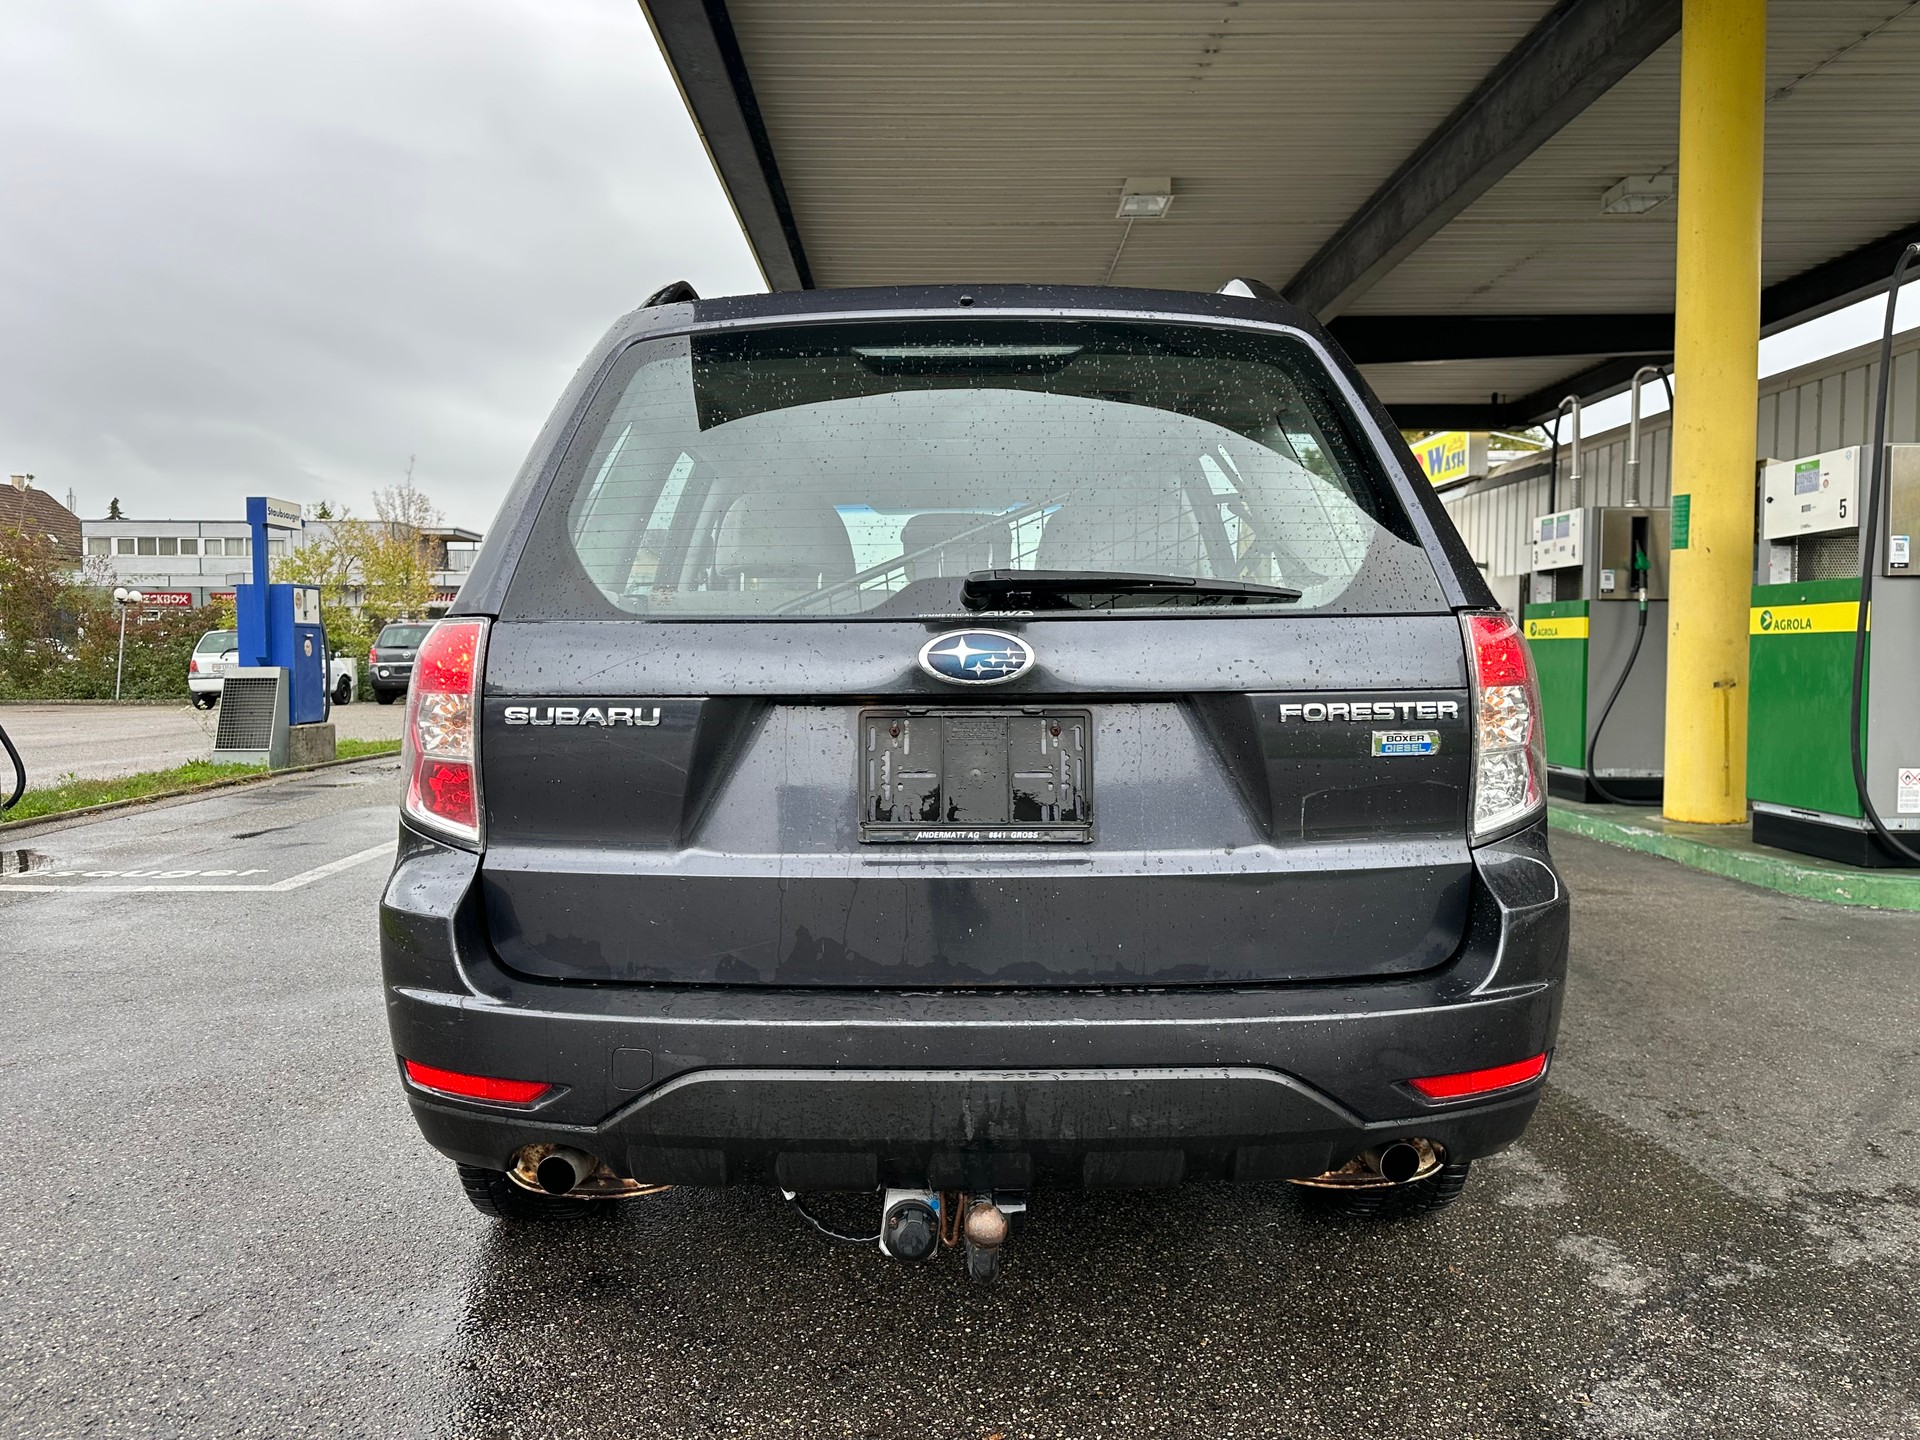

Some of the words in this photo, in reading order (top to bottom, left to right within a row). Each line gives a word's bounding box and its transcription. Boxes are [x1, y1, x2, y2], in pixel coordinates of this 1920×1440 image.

[267, 506, 300, 523] Staubsauger
[1839, 498, 1847, 518] 5
[1534, 550, 1538, 565] 3
[1571, 544, 1576, 559] 4
[140, 594, 189, 604] ECKBOX
[1773, 618, 1812, 630] AGROLA
[1537, 628, 1558, 636] AGROLA
[504, 706, 661, 727] SUBARU
[1279, 700, 1459, 723] FORESTER
[1386, 734, 1425, 742] BOXER
[1384, 743, 1427, 752] DIESEL
[915, 831, 966, 840] ANDERMATT
[967, 831, 980, 839] AG
[1010, 831, 1039, 839] GROSS
